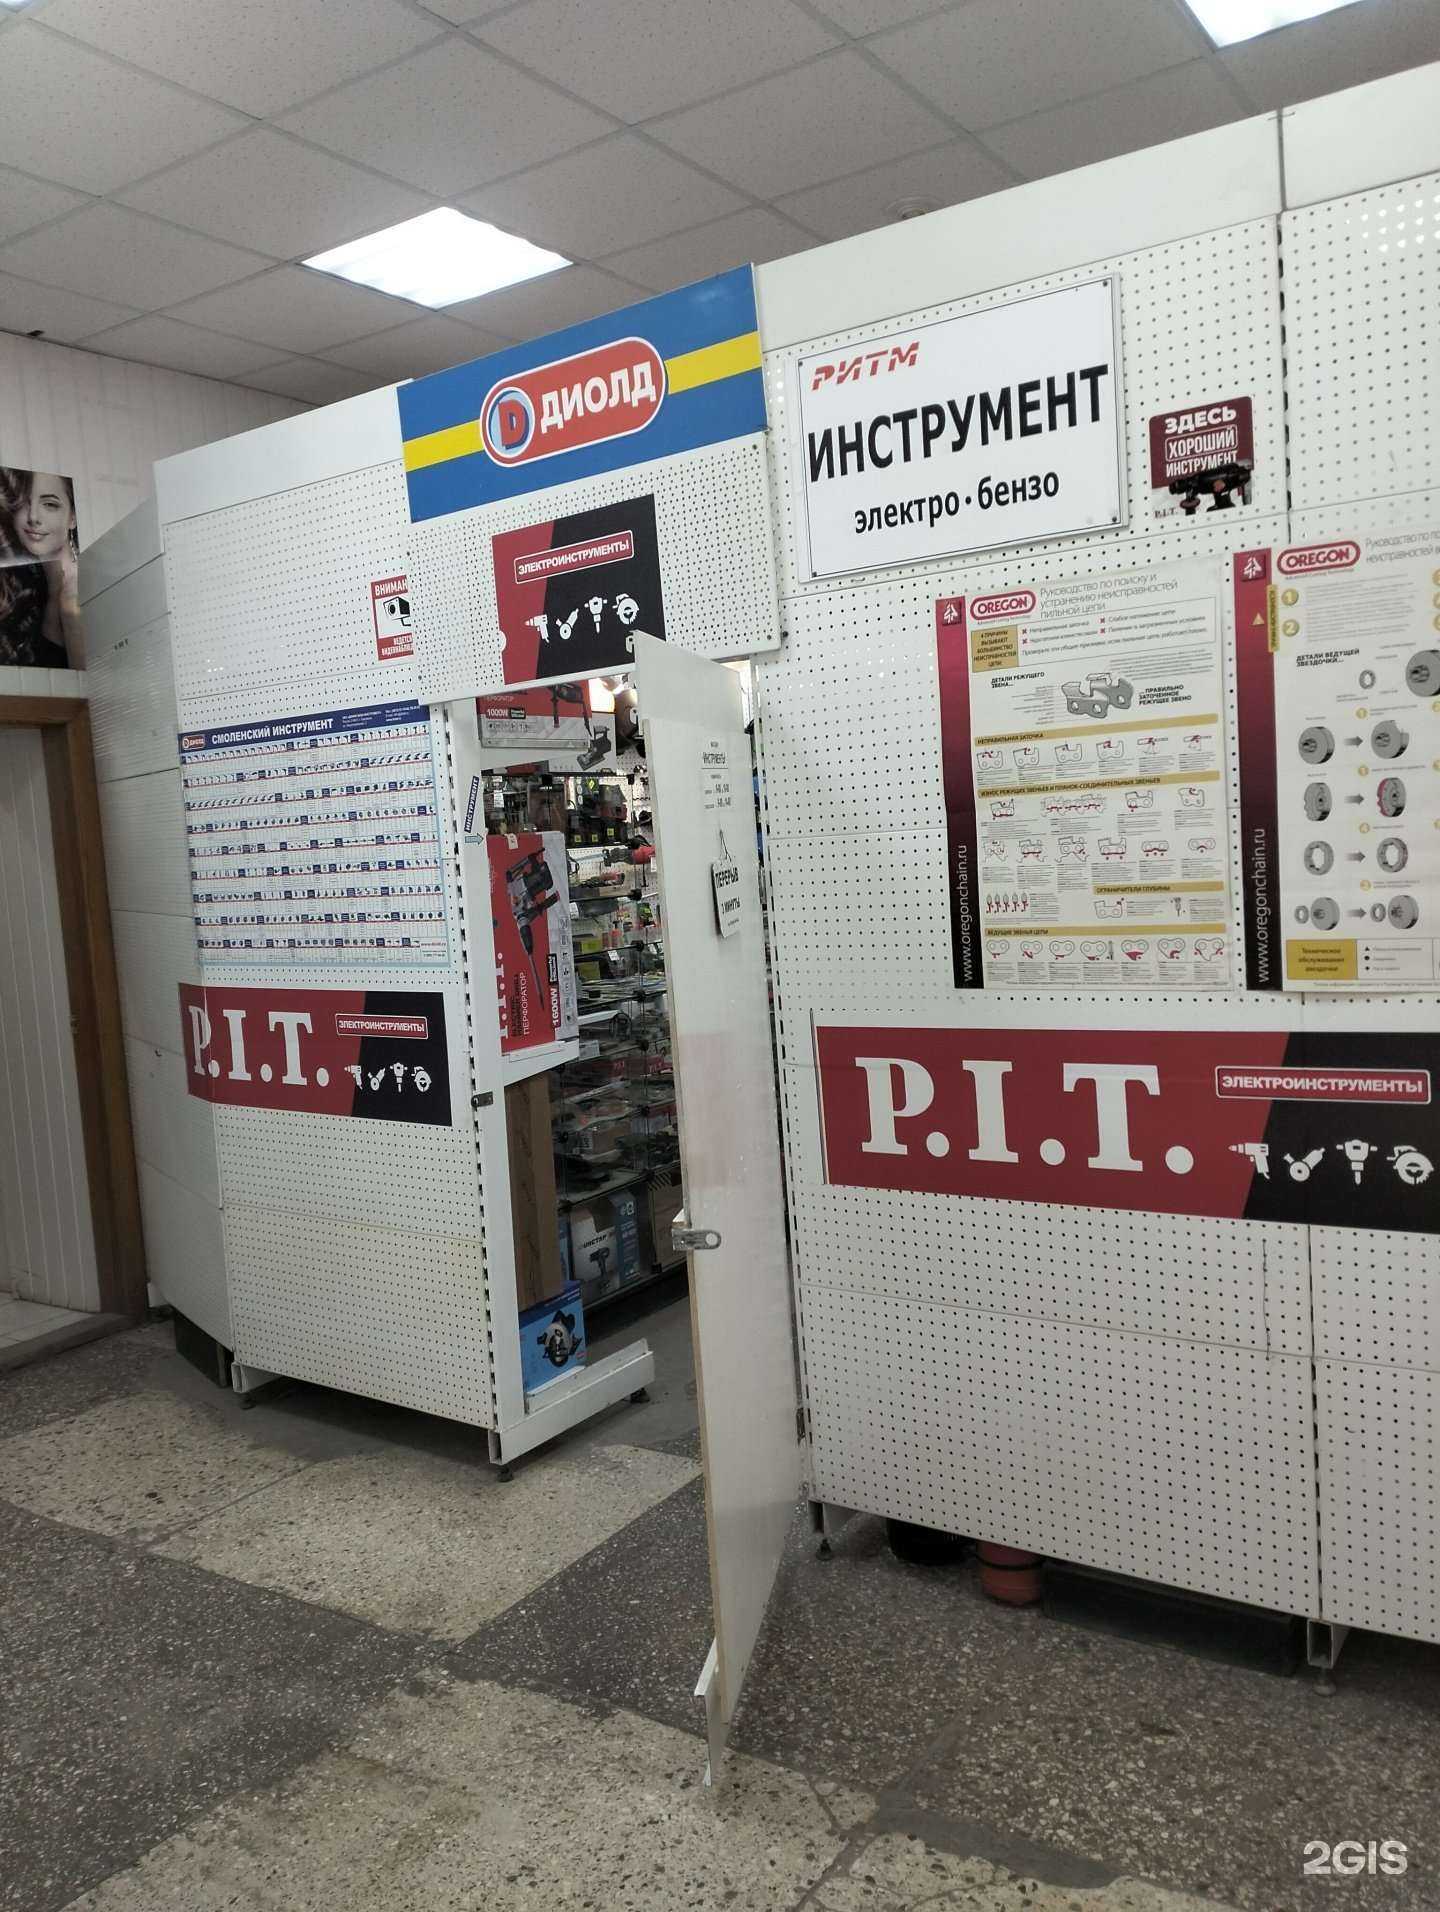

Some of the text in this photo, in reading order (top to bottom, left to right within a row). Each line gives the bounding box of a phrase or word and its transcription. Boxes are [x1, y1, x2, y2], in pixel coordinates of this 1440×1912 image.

[811, 341, 920, 391] РИТМ
[540, 361, 657, 434] ДИОЛД
[808, 364, 1108, 483] ИНСТРУМЕНТ
[1164, 406, 1237, 434] ЗДЕСЬ
[1168, 427, 1235, 459] ХОРОШИЙ
[1166, 450, 1238, 478] ИНСТРУМЕНТ
[518, 539, 630, 575] ЭЛЕКТРОИНСТРУМЕНТЫ
[1285, 547, 1350, 570] OREGON
[977, 595, 1028, 614] OREGON
[211, 718, 334, 745] СМОЛЕНСКИЙ ИНСТРУМЕНТ
[465, 777, 478, 831] ИНСТРУМЕНТ
[956, 845, 973, 982] www.oregonchain.ru
[1251, 828, 1271, 984] www.oregonchain.ru
[519, 971, 530, 1036] ПЕРФОРАТОР
[550, 988, 559, 1026] 1600W
[338, 1019, 425, 1033] ЭЛЕКТРОИНСТРУМЕНТЫ
[188, 1005, 330, 1087] P.I.T.
[1222, 1074, 1424, 1094] ЭЛЕКТРОИНСТРУМЕНТЫ
[855, 1056, 1194, 1175] P.I.T.
